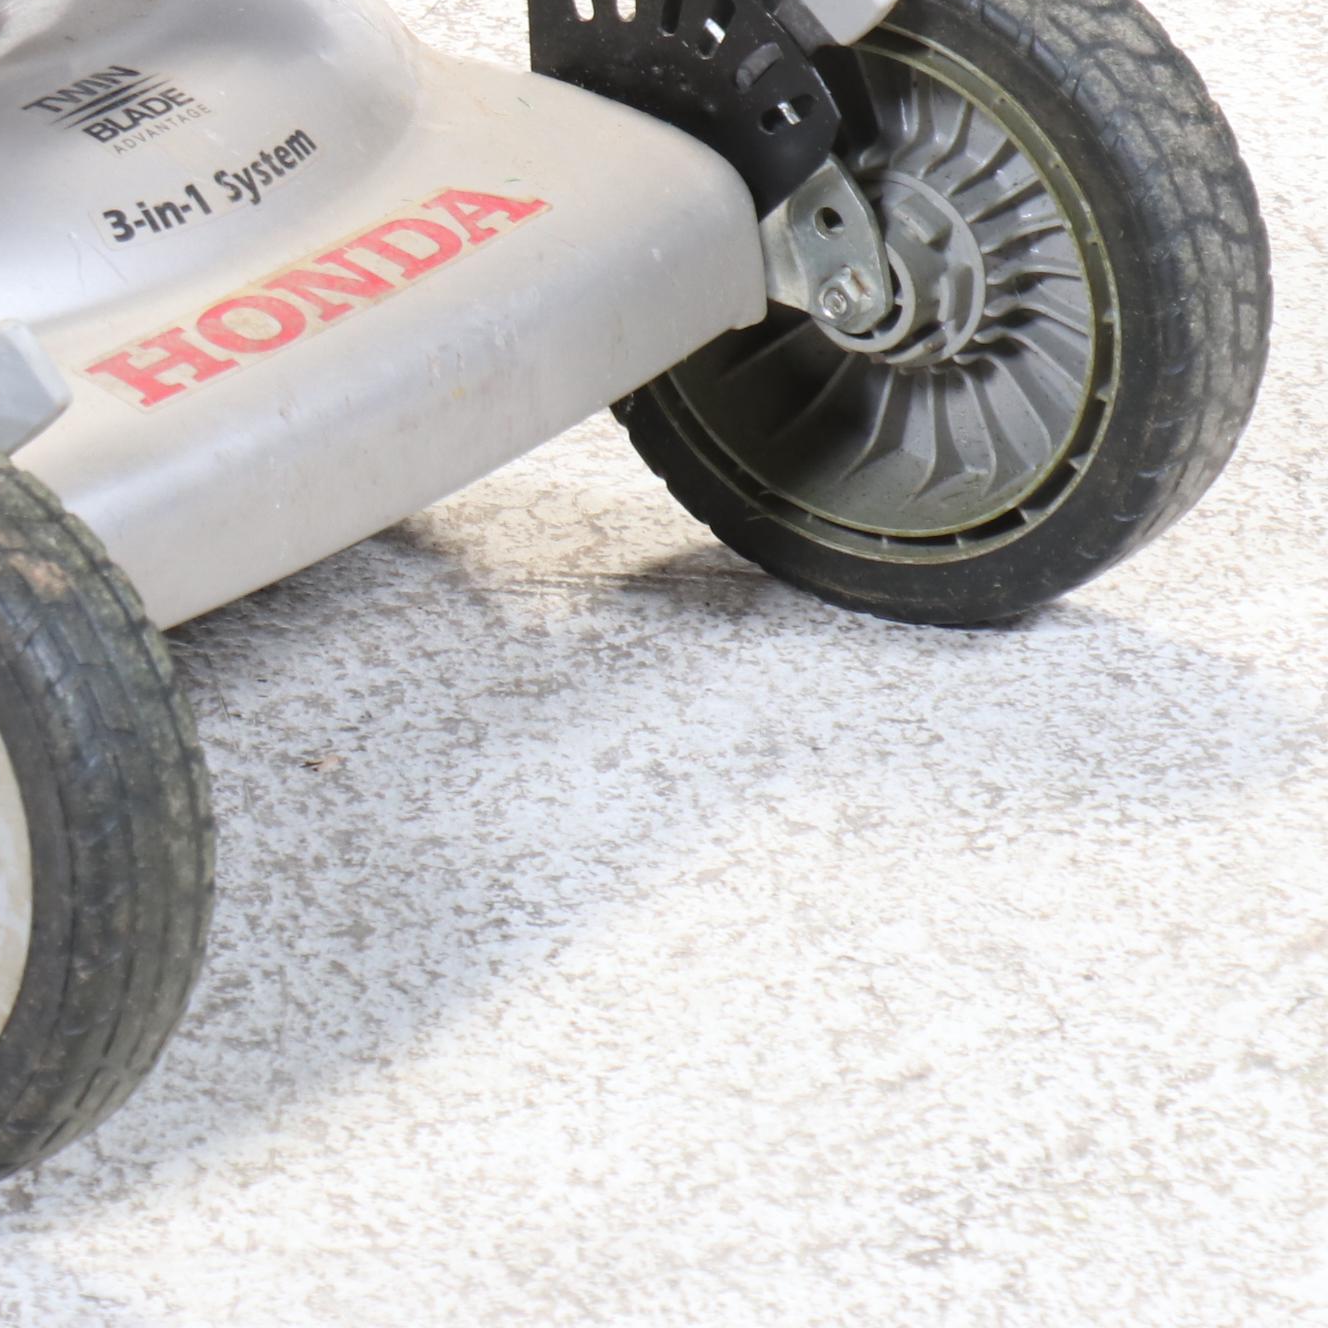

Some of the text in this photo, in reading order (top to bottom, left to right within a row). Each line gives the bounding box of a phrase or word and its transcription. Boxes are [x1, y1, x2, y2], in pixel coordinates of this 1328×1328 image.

[21, 65, 141, 113] TWIN
[81, 87, 194, 144] BLADE
[111, 102, 214, 156] ADVANTAGE
[102, 128, 318, 243] 3-in-1 System
[85, 187, 552, 408] HONDA
